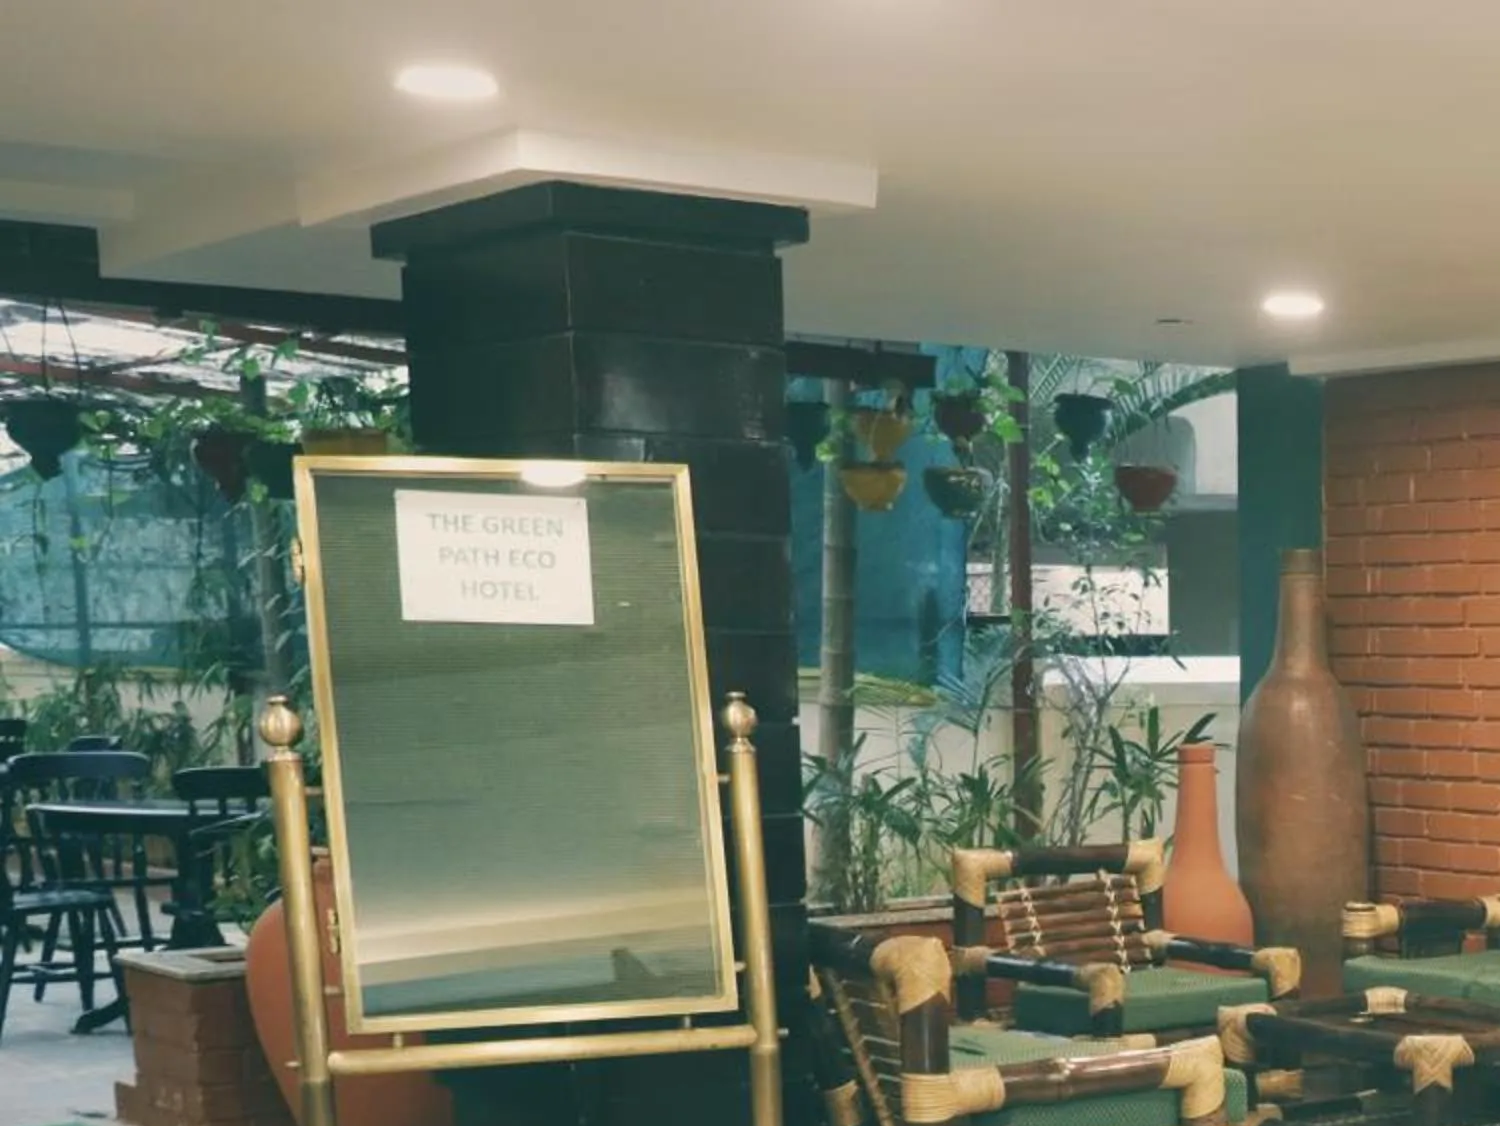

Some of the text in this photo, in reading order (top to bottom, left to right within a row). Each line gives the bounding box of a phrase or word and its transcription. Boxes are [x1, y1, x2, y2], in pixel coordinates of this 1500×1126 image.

[426, 512, 564, 538] THE GREEN
[438, 546, 557, 570] PATH ECO
[461, 579, 539, 602] HOTEL
